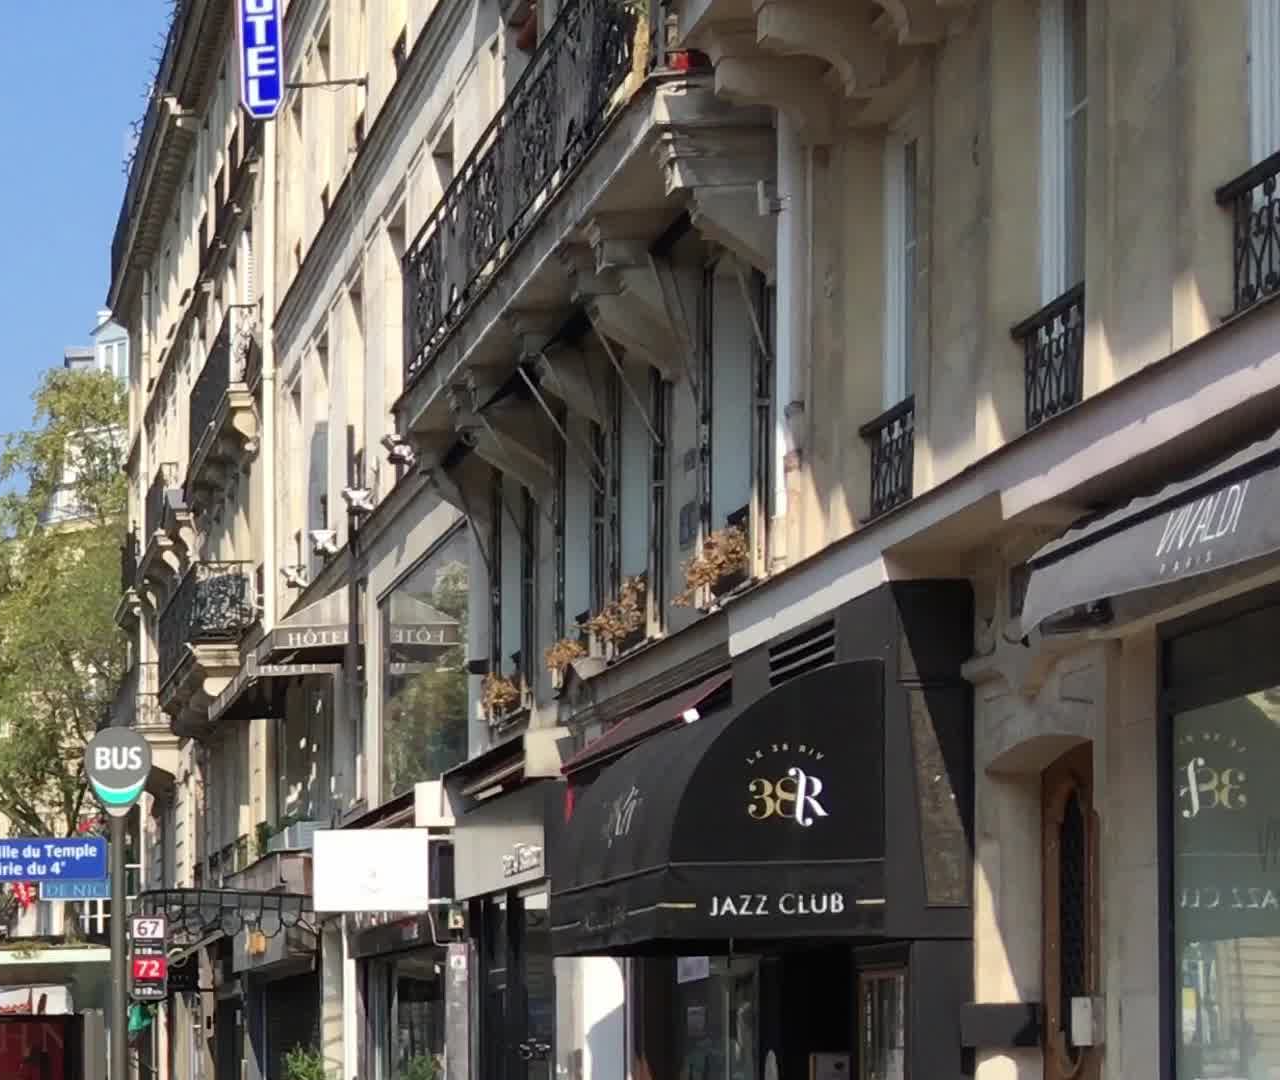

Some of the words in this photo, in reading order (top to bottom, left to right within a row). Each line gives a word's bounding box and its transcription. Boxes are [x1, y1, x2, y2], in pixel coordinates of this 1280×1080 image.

[1155, 479, 1250, 557] VIVALDI
[94, 746, 142, 771] BUS
[22, 845, 41, 859] du
[44, 844, 97, 861] Temple
[27, 861, 46, 876] du
[709, 894, 769, 917] JAZZ
[778, 892, 845, 915] CLUB
[136, 920, 160, 937] 67
[137, 959, 160, 978] 72
